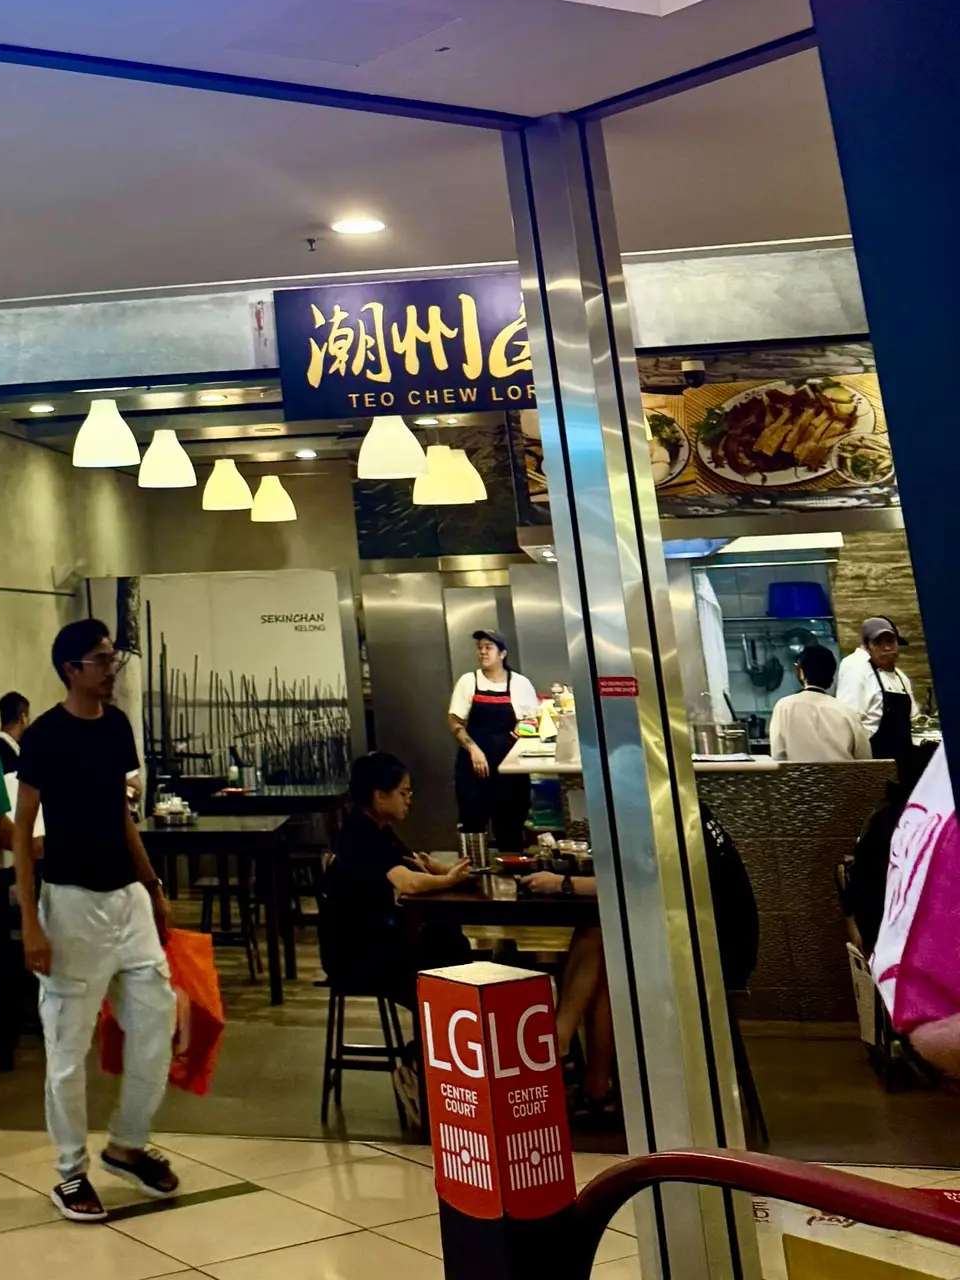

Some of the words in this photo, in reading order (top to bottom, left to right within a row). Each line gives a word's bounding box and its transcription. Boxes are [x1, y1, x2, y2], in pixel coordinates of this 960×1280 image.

[348, 392, 395, 408] TEO
[408, 387, 478, 405] CHEW
[260, 613, 325, 624] SEKINCHAN
[423, 1001, 485, 1078] LG
[488, 1004, 557, 1079] LG
[440, 1083, 478, 1104] CENTRE
[507, 1085, 549, 1104] CENTRE
[445, 1098, 476, 1118] COURT
[512, 1100, 547, 1118] COURT
